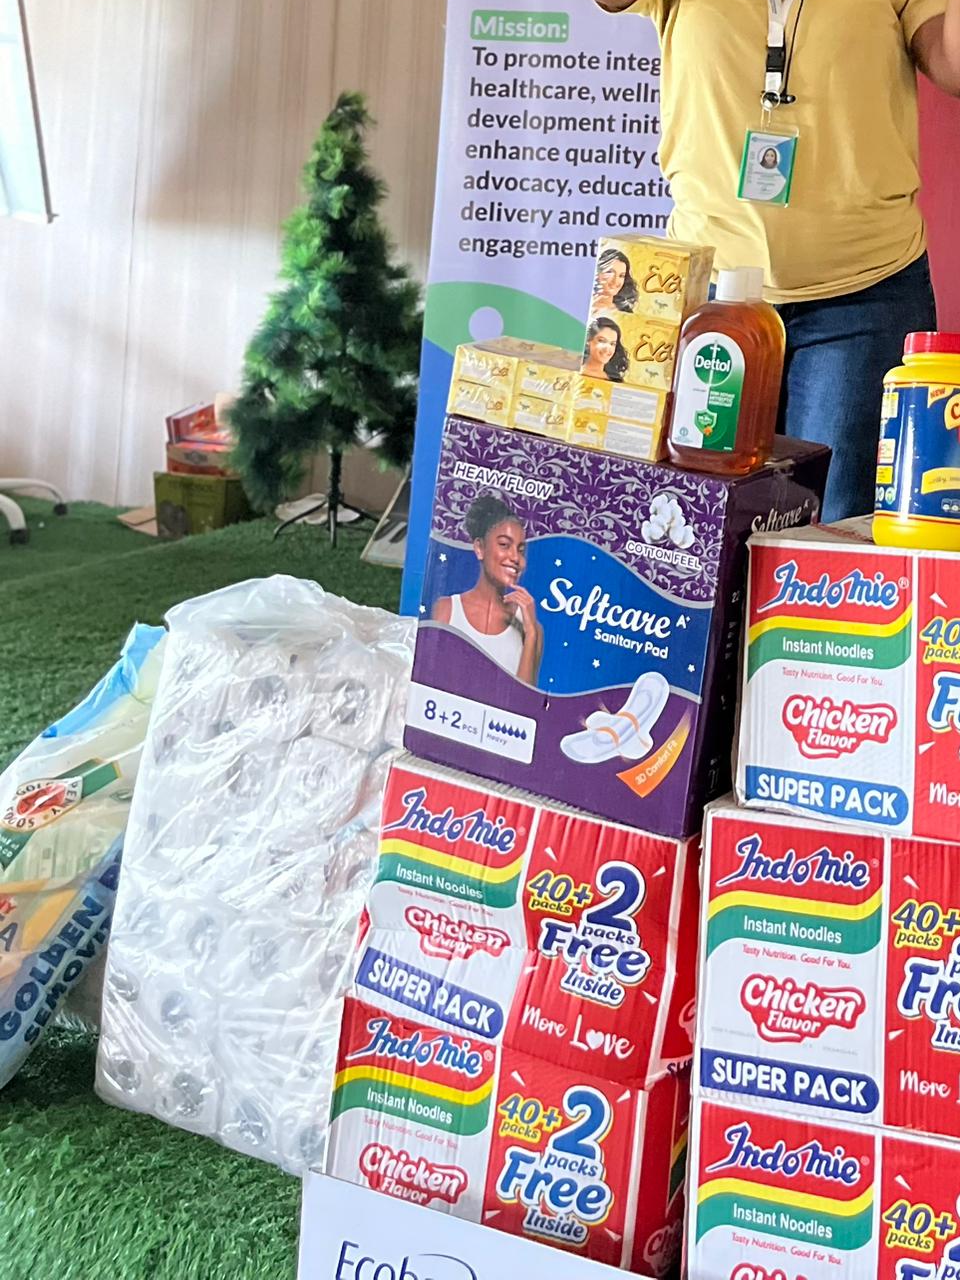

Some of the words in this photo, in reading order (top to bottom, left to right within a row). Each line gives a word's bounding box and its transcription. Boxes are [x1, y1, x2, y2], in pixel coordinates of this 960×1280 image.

[473, 16, 568, 39] Mission:
[472, 46, 498, 67] To
[503, 51, 601, 72] promote
[606, 50, 662, 77] integ
[469, 76, 596, 105] healthcare,
[601, 82, 661, 104] welln
[467, 107, 616, 135] development
[621, 113, 661, 135] init
[464, 138, 561, 162] enhance
[565, 143, 646, 170] quality
[463, 170, 573, 198] advocacy,
[460, 200, 553, 228] delivery
[558, 205, 600, 227] and
[605, 211, 671, 230] comm
[457, 236, 599, 259] engagement
[642, 263, 683, 295] Eva
[633, 333, 675, 363] Eva
[695, 354, 731, 373] Dettol
[453, 461, 506, 489] HEAVY
[504, 476, 554, 501] FLOW
[625, 541, 673, 565] COTTON
[672, 551, 702, 571] FEEL
[756, 559, 900, 614] Indomie
[540, 577, 671, 639] Softcare
[593, 628, 644, 654] Sanitary
[644, 641, 669, 660] Pad
[782, 636, 823, 655] Instant
[825, 641, 874, 660] Noodles
[836, 672, 856, 684] Good
[856, 674, 869, 684] For
[462, 723, 478, 736] PCS
[785, 697, 894, 737] Chicken
[807, 727, 857, 749] Flavor
[756, 773, 825, 808] SUPER
[829, 784, 898, 819] PACK
[381, 786, 517, 855] Indomie
[714, 832, 871, 890] Indomie
[396, 863, 434, 887] Instant
[436, 876, 484, 900] Noodles
[530, 899, 571, 915] packs
[586, 865, 640, 932] 2
[405, 908, 509, 950] Chicken
[580, 926, 636, 946] packs
[743, 915, 787, 937] Instant
[790, 922, 843, 945] Noodles
[896, 930, 940, 948] packs
[541, 921, 646, 977] Free
[742, 943, 762, 958] Tasty
[801, 953, 821, 966] Good
[822, 955, 835, 967] For
[0, 895, 105, 1042] GOLDEN
[563, 966, 622, 1002] Inside
[368, 958, 431, 1006] SUPER
[432, 985, 496, 1033] PACK
[744, 977, 862, 1022] Chicken
[521, 1003, 568, 1038] More
[767, 1009, 821, 1034] Flavor
[344, 1016, 483, 1078] Indomie
[711, 1056, 787, 1095] SUPER
[793, 1070, 868, 1107] PACK
[899, 1069, 951, 1099] More
[367, 1087, 406, 1111] Instant
[407, 1096, 453, 1125] Noodles
[500, 1120, 539, 1140] packs
[552, 1089, 606, 1161] 2
[543, 1151, 599, 1178] packs
[704, 1120, 862, 1188] Indomie
[362, 1146, 465, 1198] Chicken
[499, 1150, 606, 1216] Free
[380, 1175, 428, 1204] Flavor
[525, 1207, 585, 1239] Inside
[733, 1202, 777, 1227] Instant
[779, 1212, 833, 1240] Noodles
[731, 1231, 750, 1247] Tasty
[790, 1246, 811, 1260] Good
[812, 1251, 826, 1263] For
[887, 1231, 932, 1250] packs
[335, 1239, 422, 1280] Ecob
